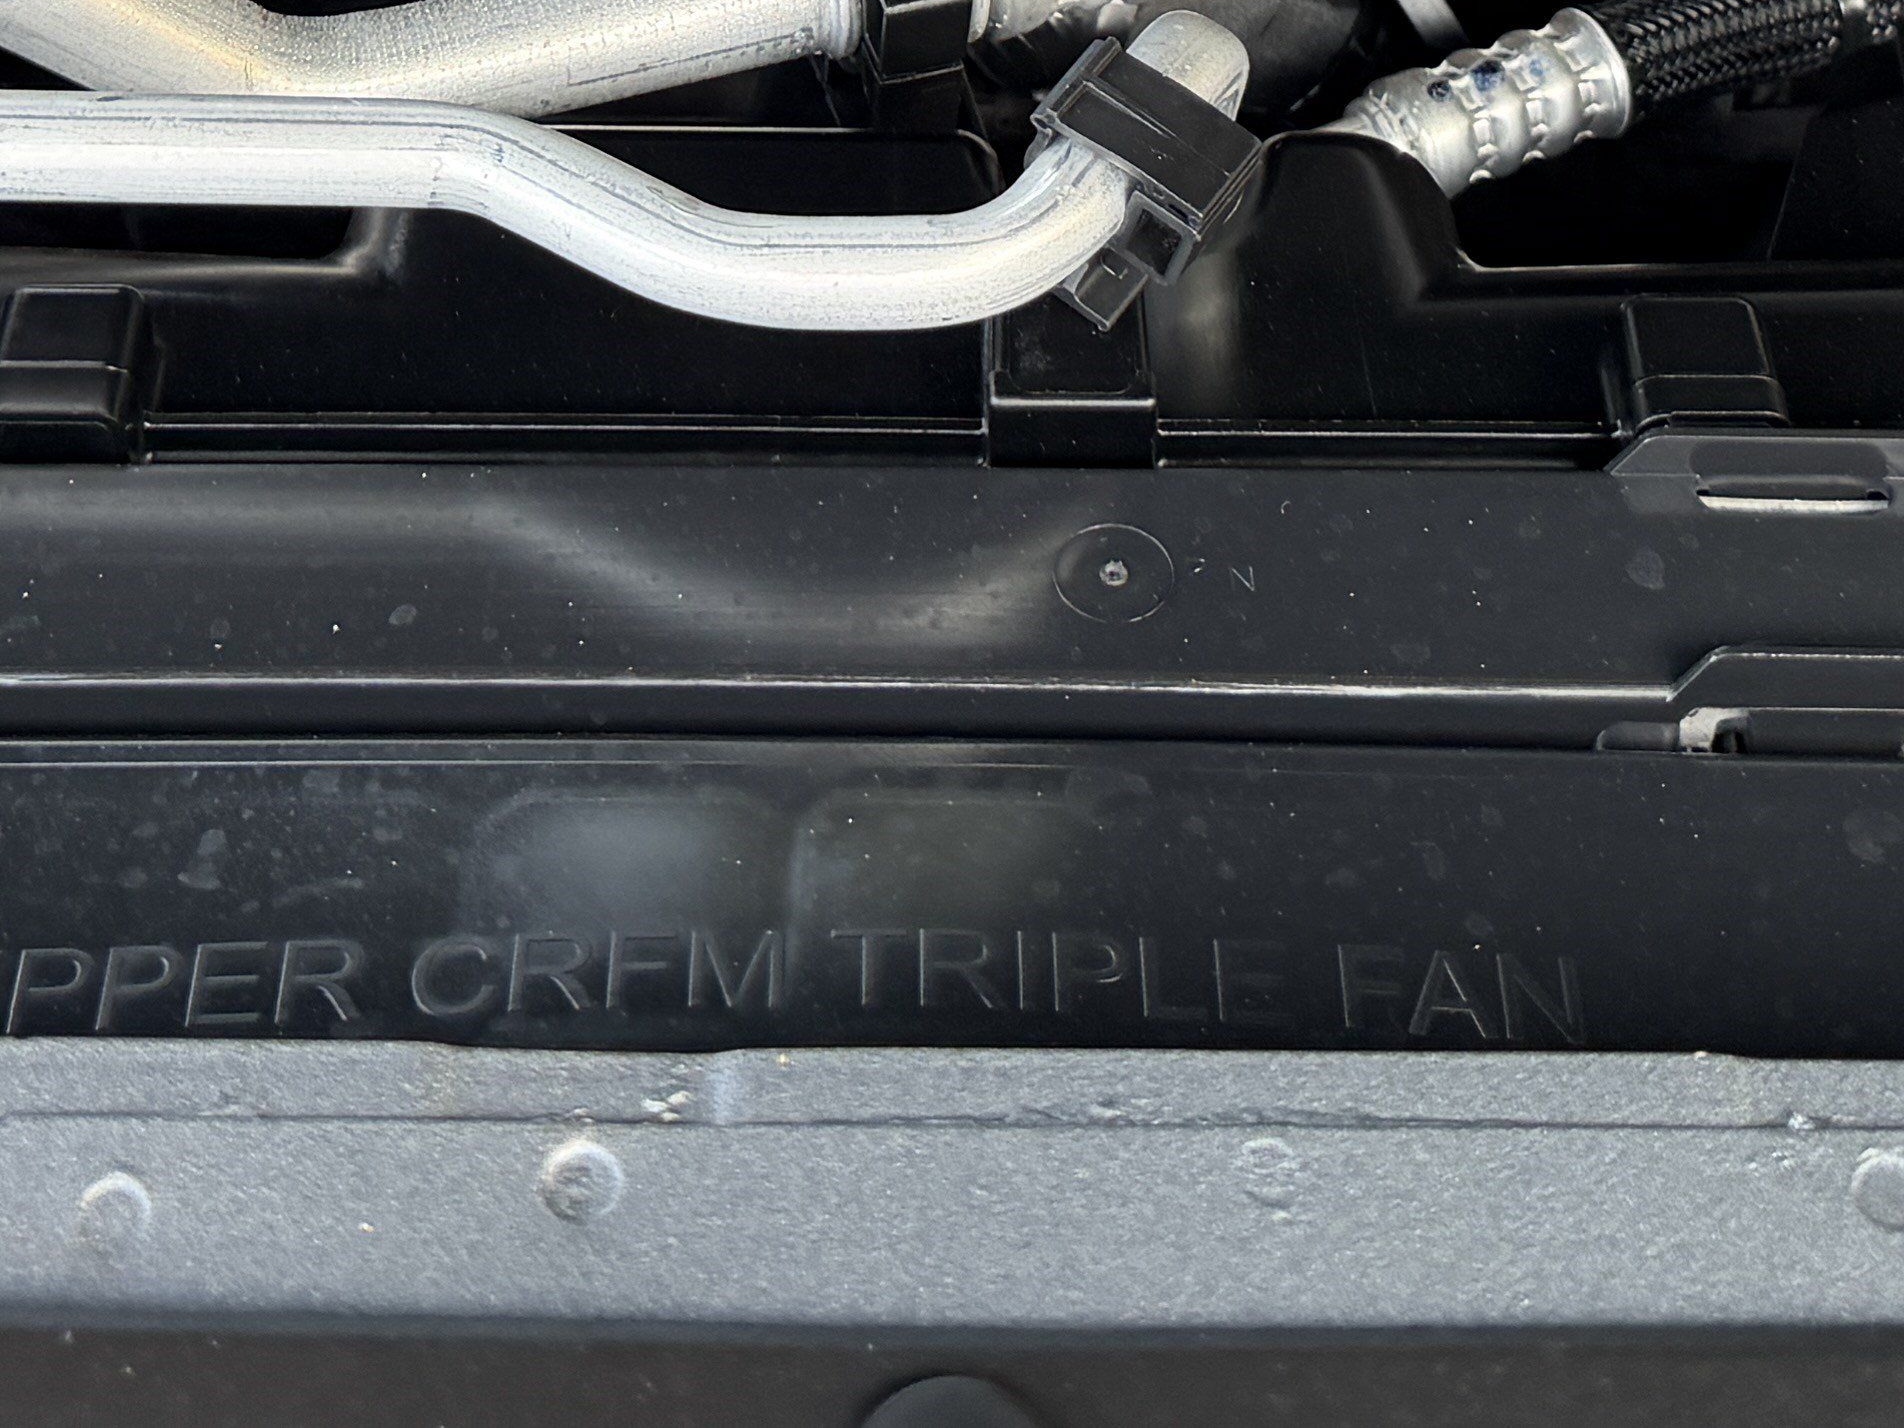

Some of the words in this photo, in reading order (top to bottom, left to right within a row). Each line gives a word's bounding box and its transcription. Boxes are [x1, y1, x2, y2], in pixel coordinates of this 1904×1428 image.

[410, 929, 785, 1017] CRFM
[830, 928, 1293, 1023] TRIPLE
[1336, 943, 1587, 1045] FAN
